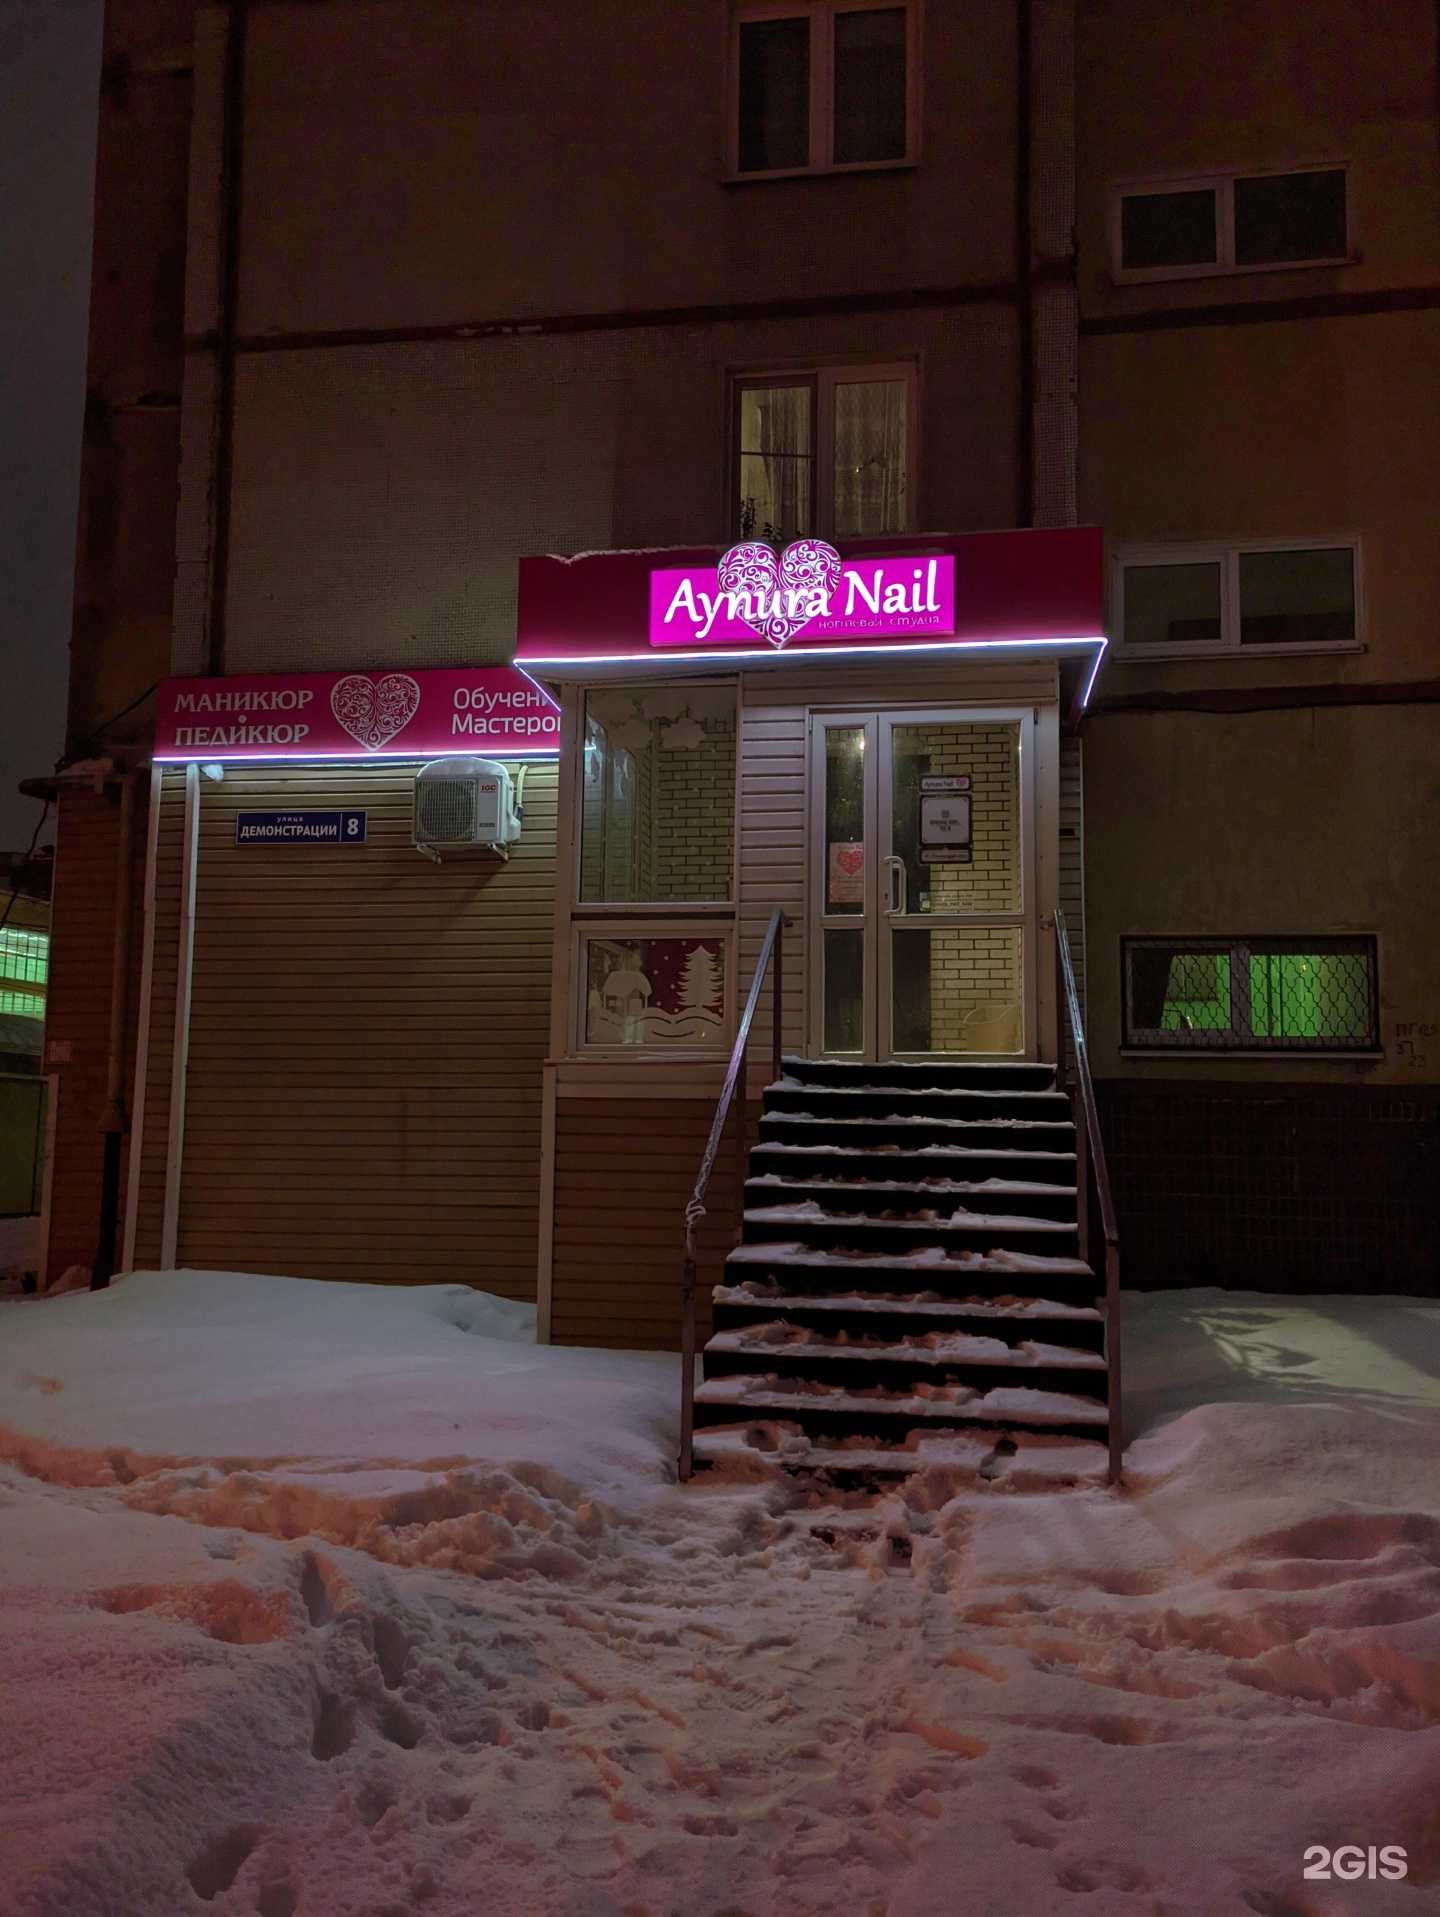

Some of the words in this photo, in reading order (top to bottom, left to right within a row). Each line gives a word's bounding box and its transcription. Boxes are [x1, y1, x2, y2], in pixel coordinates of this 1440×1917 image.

[664, 578, 832, 638] Aynura
[844, 560, 941, 615] Nail
[174, 690, 313, 712] МАНИКЮР
[174, 724, 310, 746] ПЕДИКЮР
[240, 825, 338, 838] ДЕМОНСТРАЦИИ
[347, 818, 359, 836] 8
